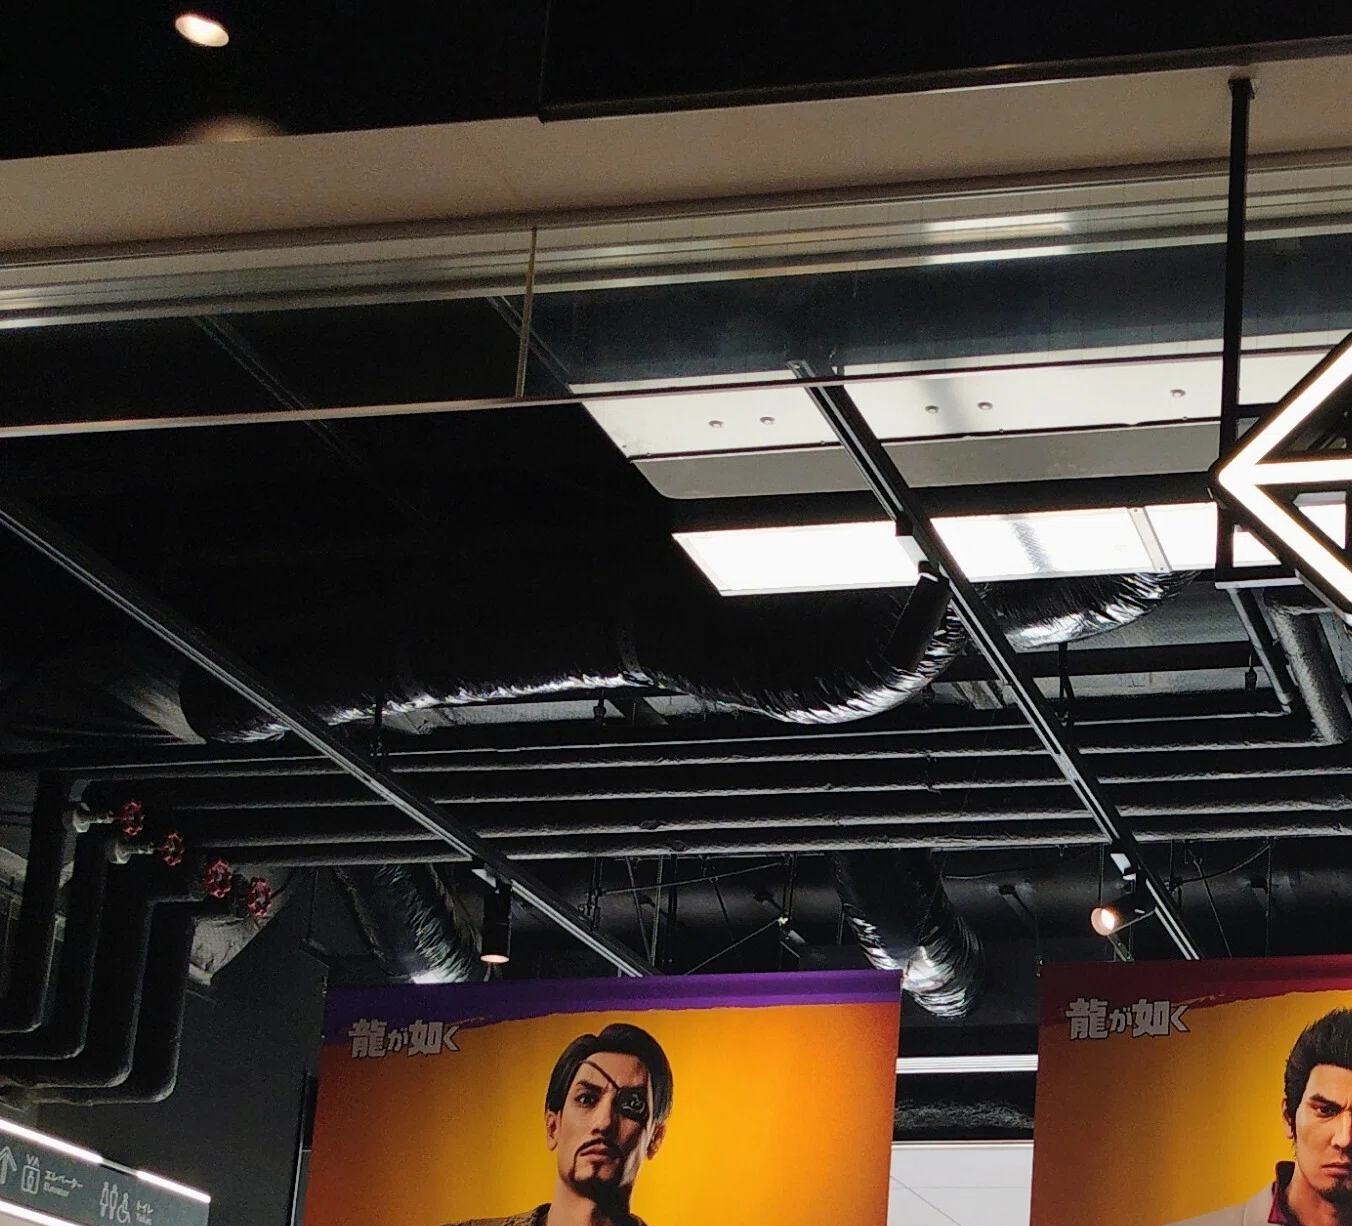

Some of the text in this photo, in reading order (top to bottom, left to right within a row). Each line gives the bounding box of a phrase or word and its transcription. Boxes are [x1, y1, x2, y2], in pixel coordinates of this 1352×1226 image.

[348, 1018, 460, 1059] 龍が如く
[1065, 997, 1190, 1040] 龍が如く
